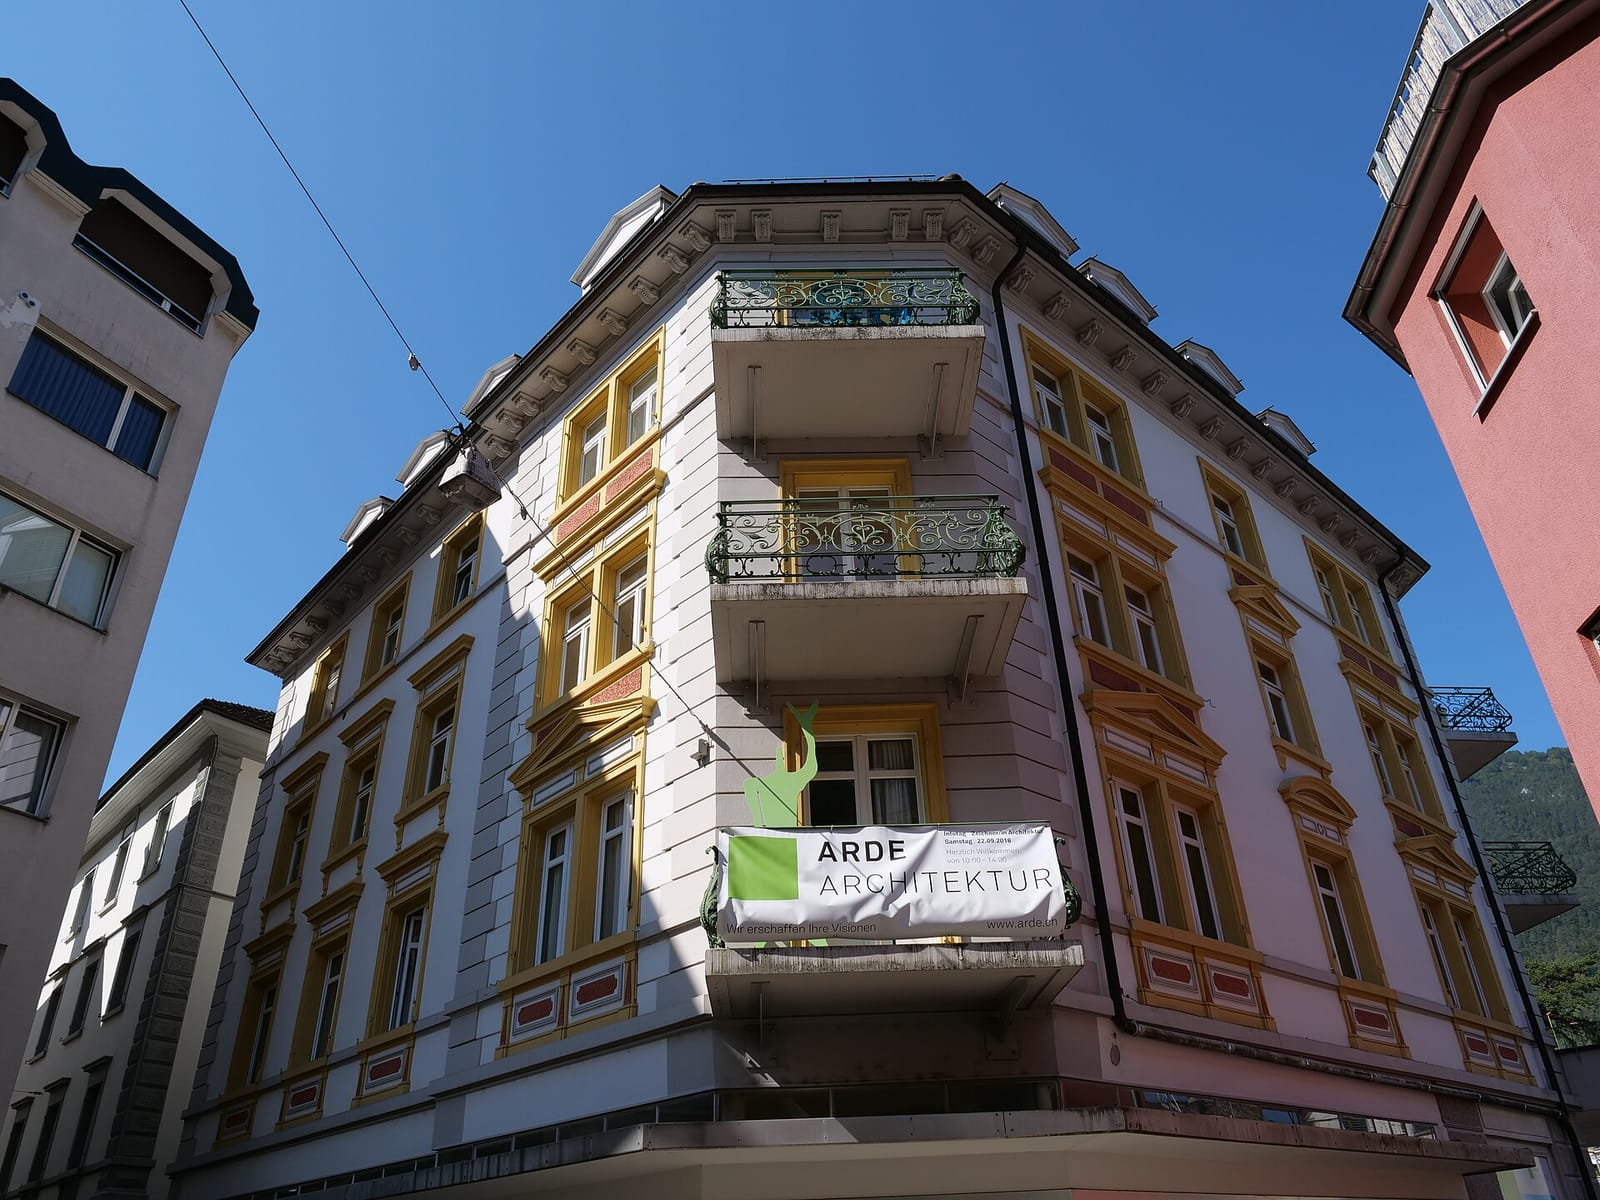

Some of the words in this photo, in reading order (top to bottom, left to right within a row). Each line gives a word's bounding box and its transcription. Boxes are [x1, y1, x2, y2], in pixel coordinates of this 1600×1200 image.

[944, 838, 973, 846] Samstag
[817, 840, 906, 863] ARDE
[946, 847, 975, 855] Herzlich
[819, 868, 1053, 896] ARCHITEKTUR
[726, 923, 745, 934] Wir
[746, 923, 806, 934] erschaffen
[808, 923, 829, 933] Ihre
[831, 923, 877, 933] Visionen
[986, 917, 1058, 929] www.arde.ch
